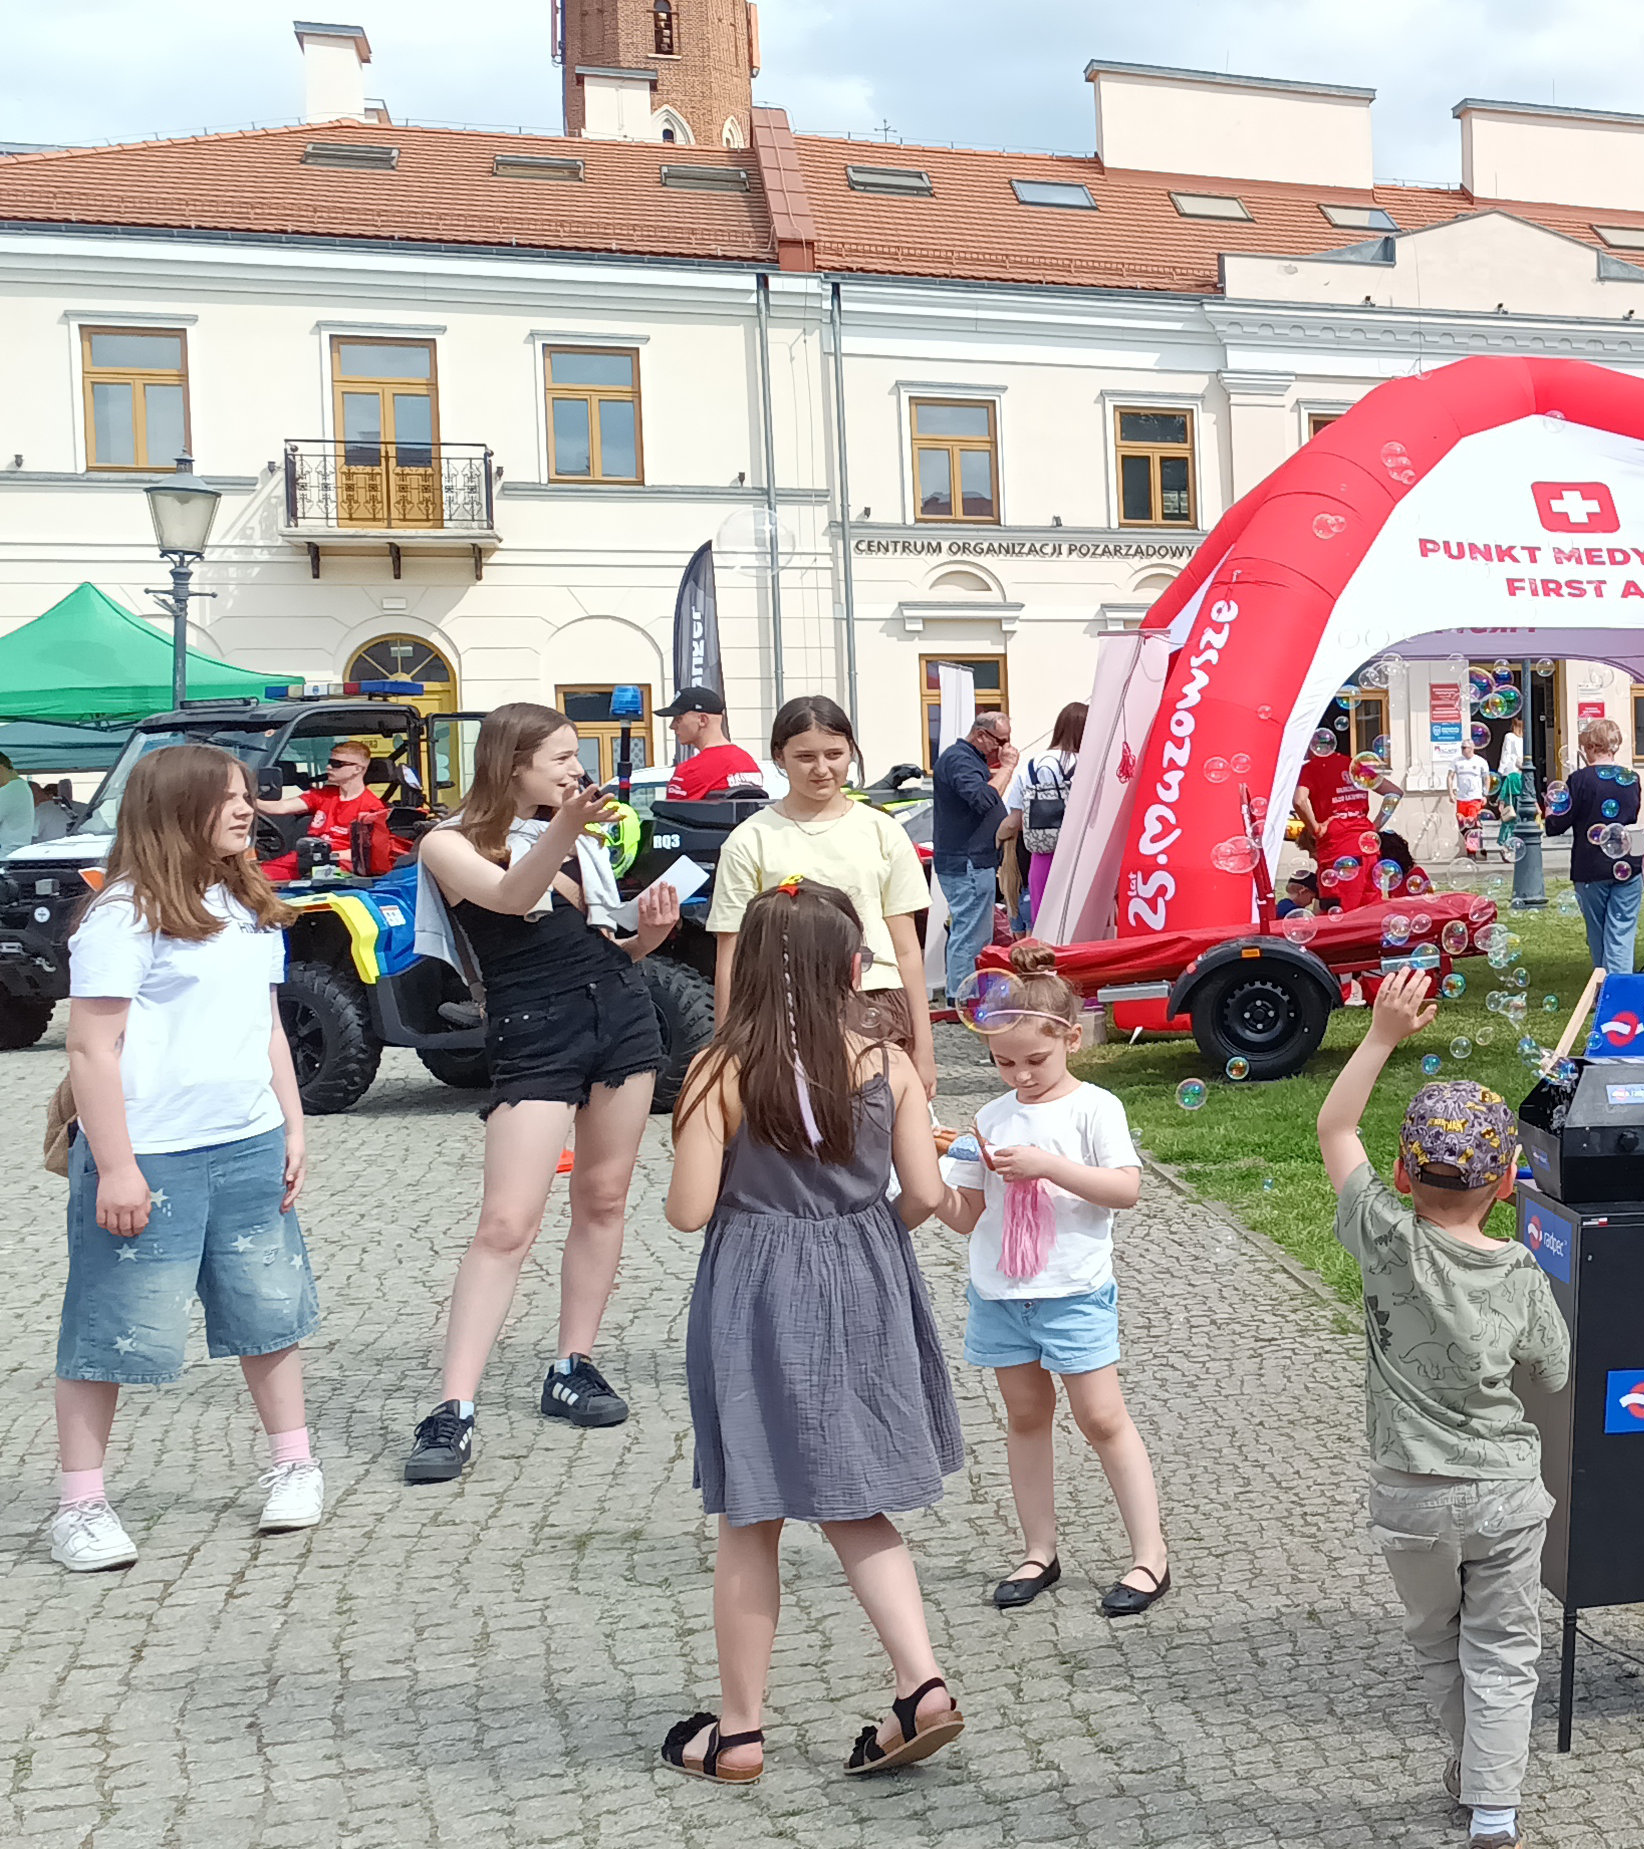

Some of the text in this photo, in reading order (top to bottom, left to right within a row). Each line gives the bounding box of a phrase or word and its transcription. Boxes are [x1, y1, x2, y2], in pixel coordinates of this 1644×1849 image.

[854, 540, 1201, 560] CENTRUM ORGANIZACJI POZARZĄDOWY
[1418, 538, 1542, 565] PUNKT
[1506, 577, 1607, 599] FIRST
[1543, 1231, 1564, 1258] radpec
